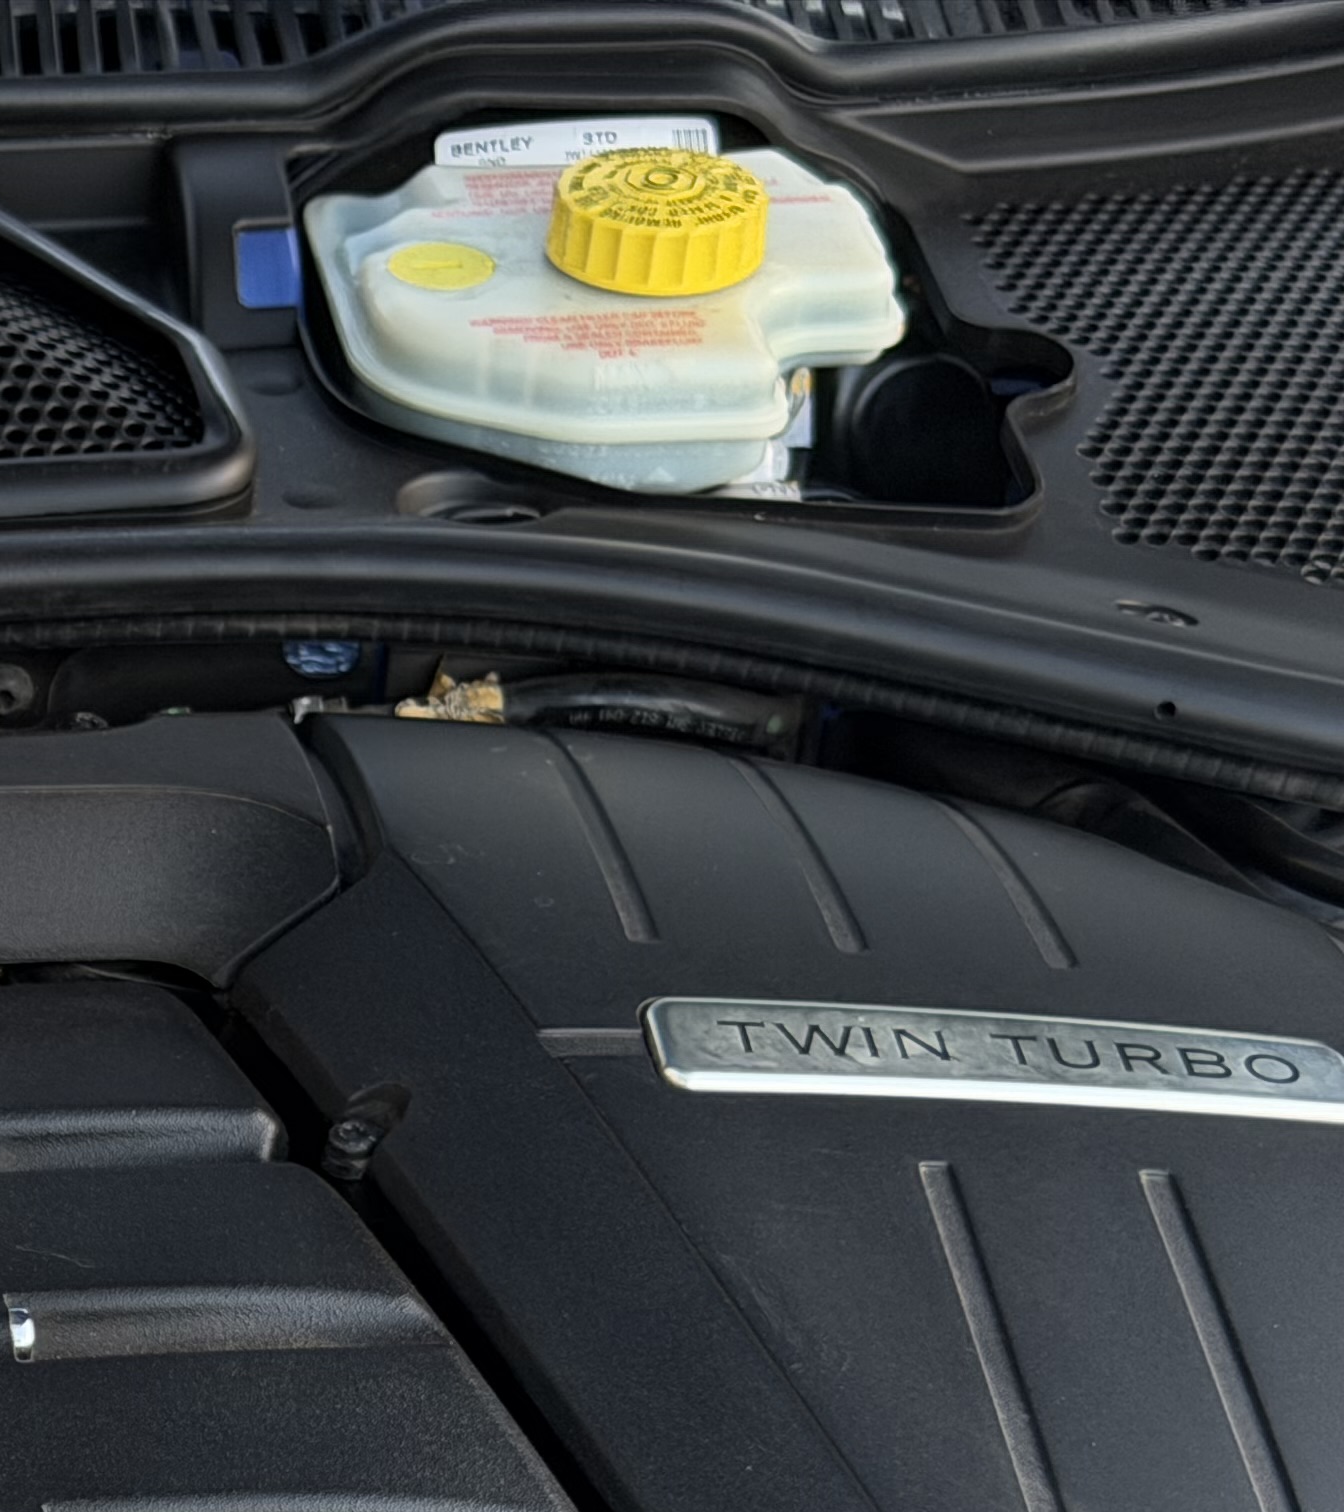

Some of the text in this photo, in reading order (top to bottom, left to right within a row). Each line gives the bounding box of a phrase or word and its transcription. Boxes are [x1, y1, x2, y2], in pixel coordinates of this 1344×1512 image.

[450, 135, 533, 158] BENTLEY
[716, 1020, 1301, 1085] TWIN TURBO
